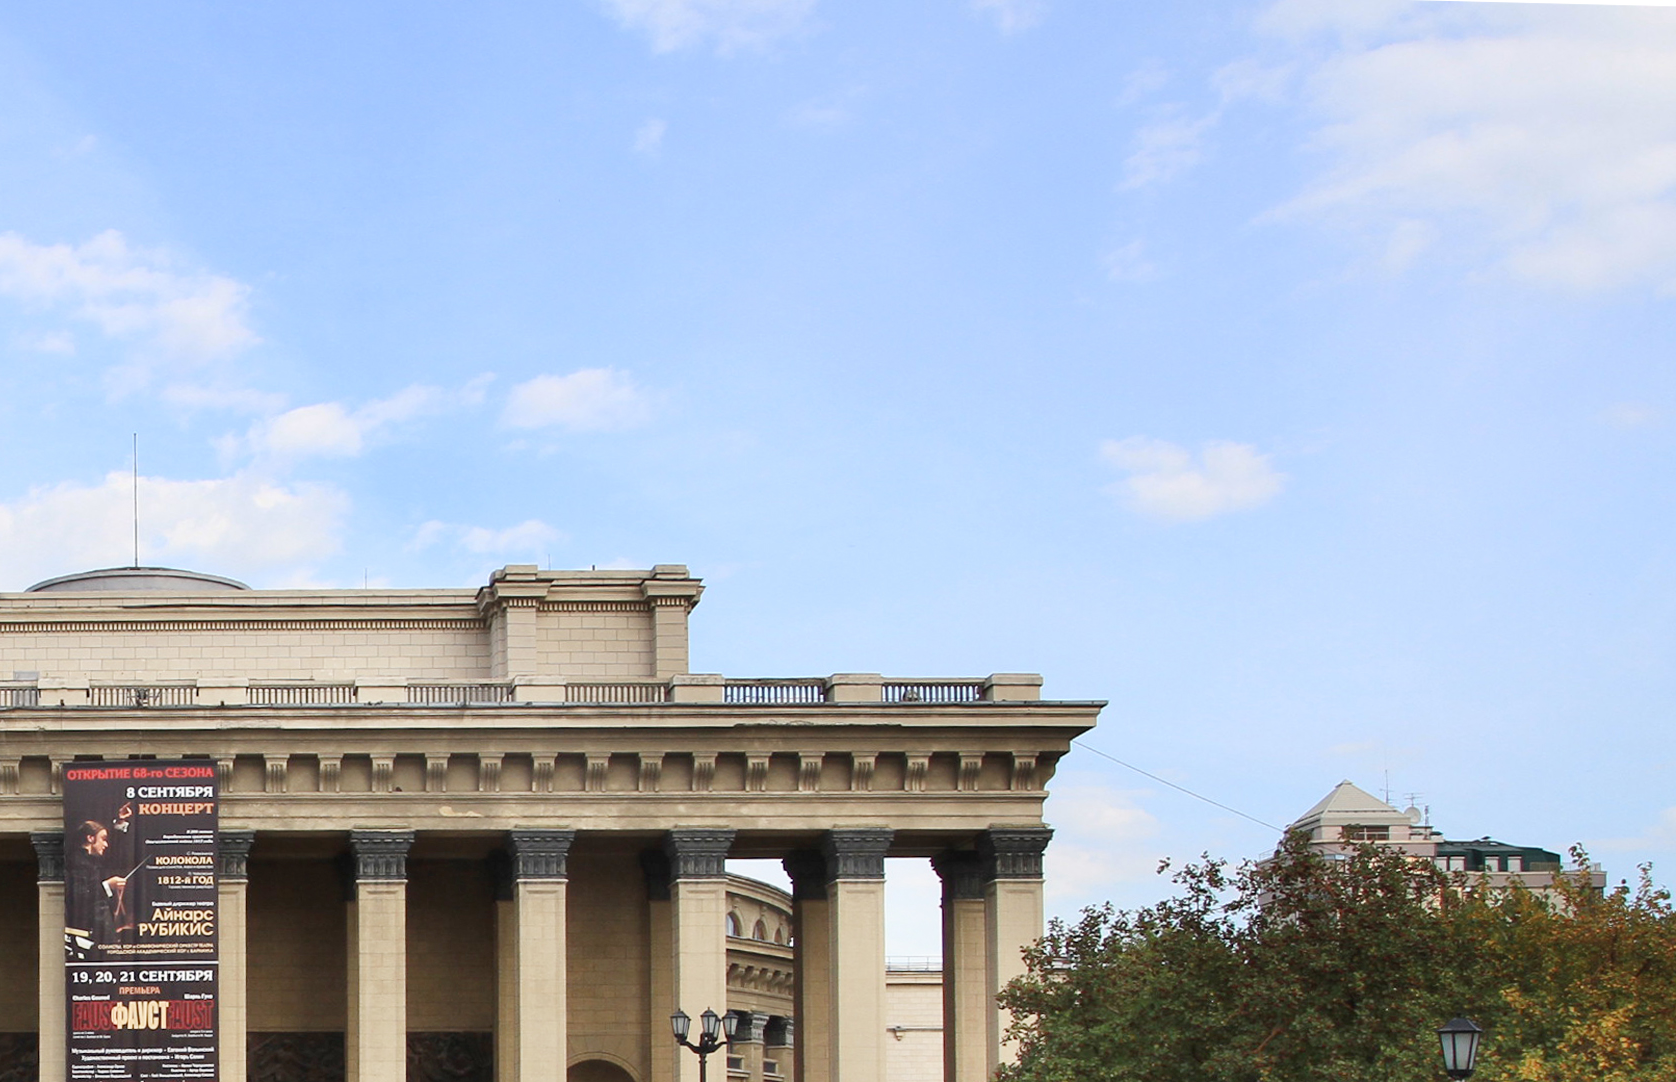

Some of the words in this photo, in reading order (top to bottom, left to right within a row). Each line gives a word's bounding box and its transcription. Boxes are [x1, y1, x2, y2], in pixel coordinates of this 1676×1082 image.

[67, 768, 131, 780] ОТКРЫТИЕ
[133, 768, 163, 778] 68-го
[165, 767, 214, 778] СЕЗОНА
[126, 788, 135, 798] 8
[138, 786, 213, 798] СЕНТЯБРЯ
[138, 803, 214, 816] КОНЦЕРТ
[155, 856, 213, 865] КОЛОКОЛА
[157, 875, 191, 885] 1812-й
[192, 875, 214, 885] ГОД
[152, 908, 214, 921] Айнарс
[138, 923, 214, 936] РУБИКИС
[72, 972, 92, 984] 19,
[95, 971, 117, 984] 20,
[119, 971, 135, 982] 21
[139, 970, 213, 982] СЕНТЯБРЯ
[119, 986, 161, 995] ПРЕМЬЕРА
[72, 1001, 116, 1031] FAUS
[111, 1000, 169, 1030] ФАУСТ
